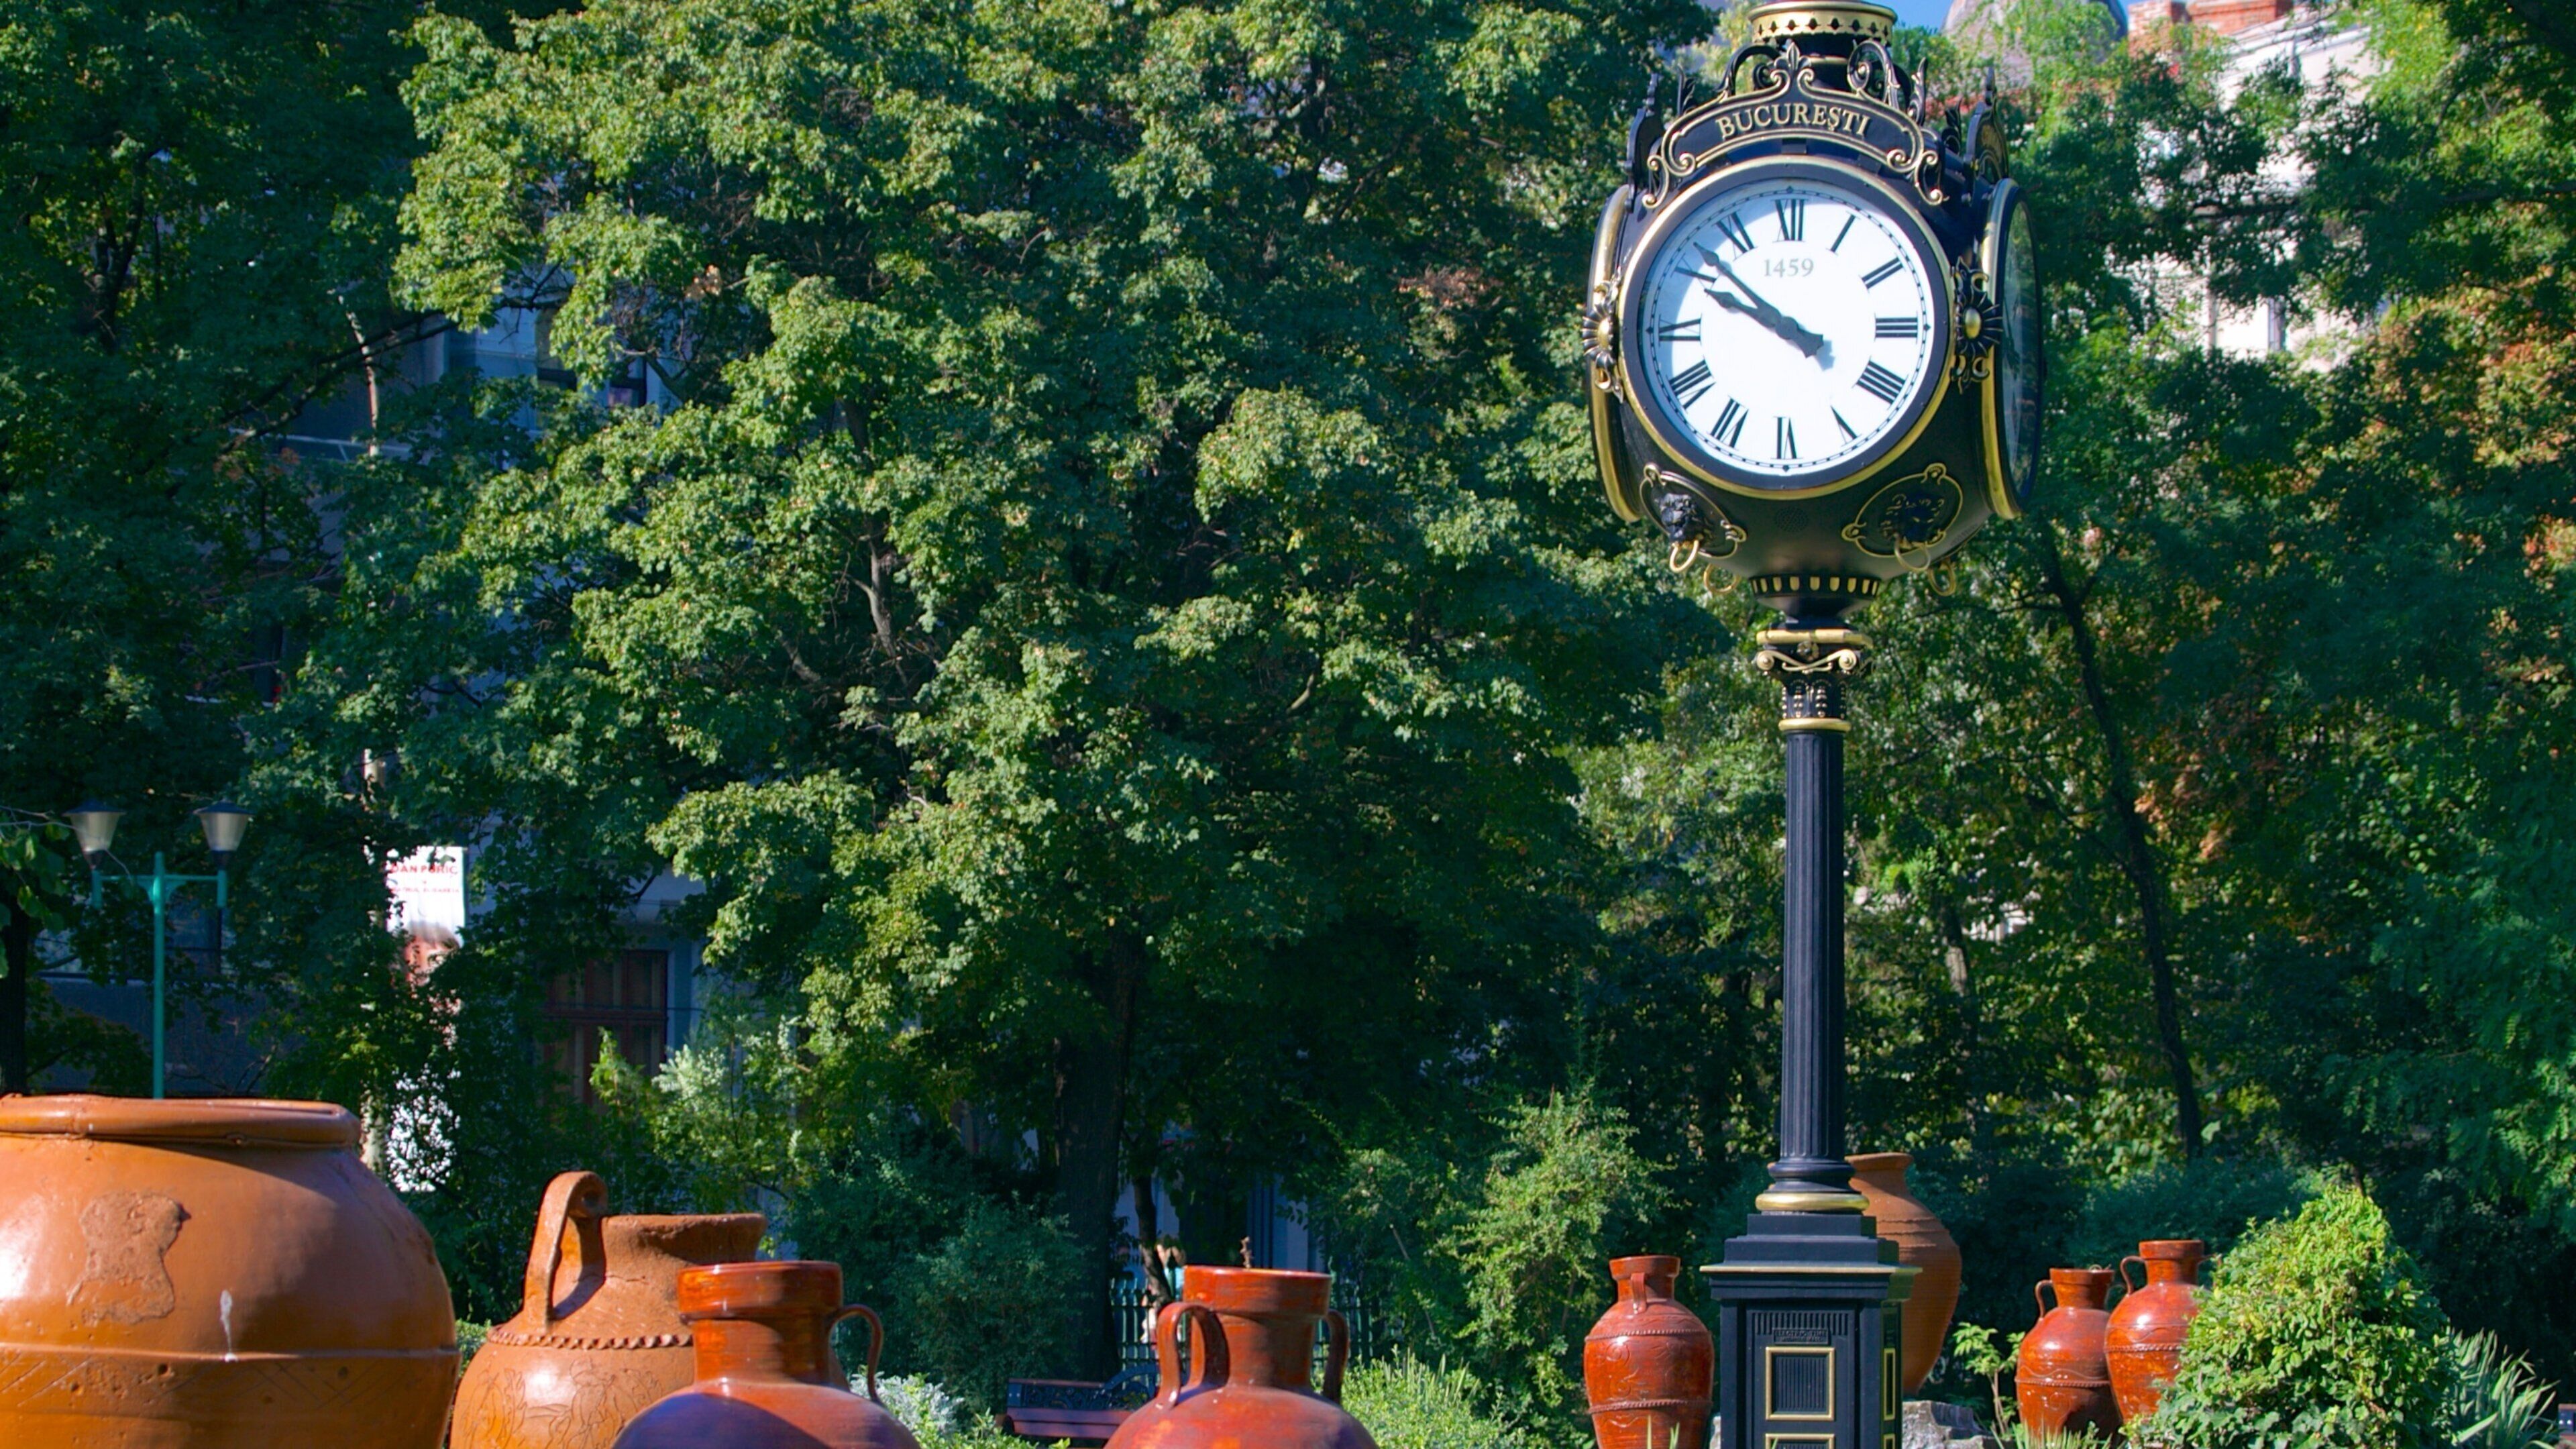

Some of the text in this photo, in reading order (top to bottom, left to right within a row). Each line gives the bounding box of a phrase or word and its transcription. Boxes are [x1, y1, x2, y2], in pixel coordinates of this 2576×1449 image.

[1712, 209, 1758, 261] XI
[1772, 199, 1808, 242] XII
[1826, 211, 1861, 256] I
[1764, 258, 1814, 278] 1459
[1858, 253, 1906, 294] II
[1658, 313, 1703, 347] IX
[1874, 311, 1918, 343] III
[1666, 354, 1716, 414] VIII
[1707, 394, 1749, 451] VII
[1770, 416, 1804, 460] VI
[1830, 405, 1862, 447] V
[390, 864, 417, 873] DAN
